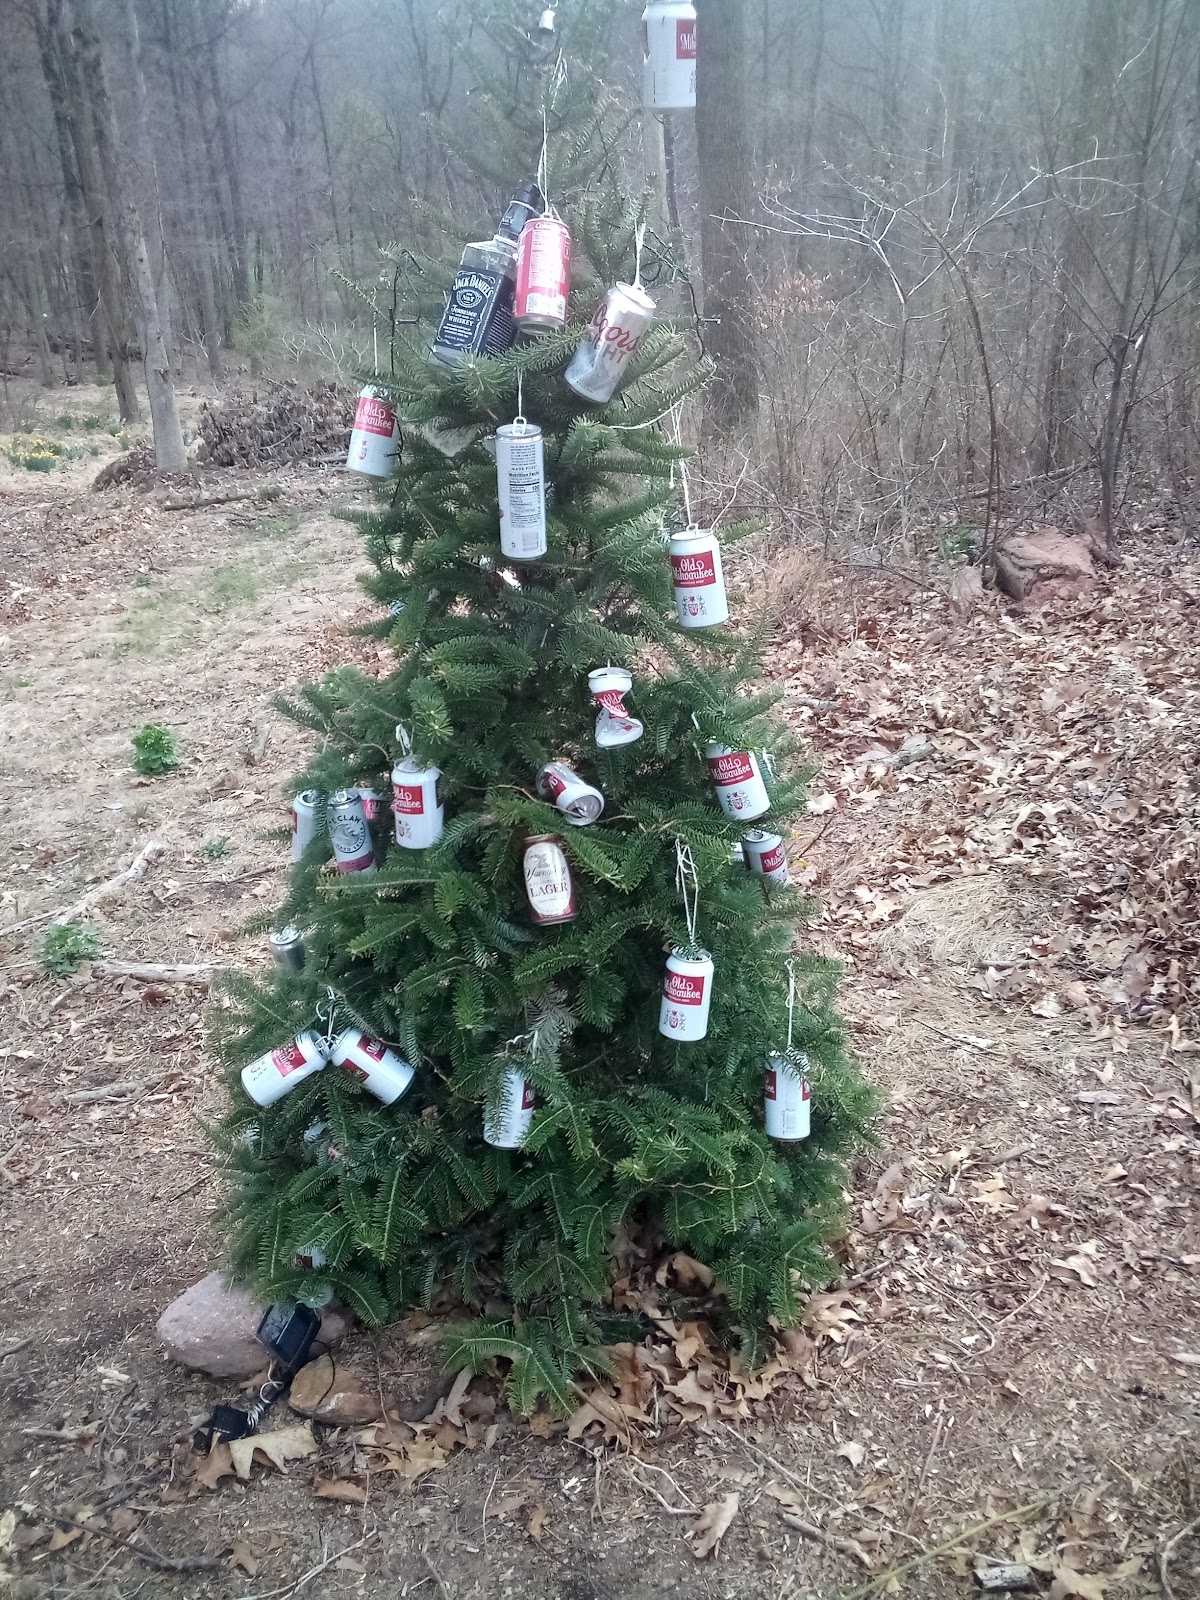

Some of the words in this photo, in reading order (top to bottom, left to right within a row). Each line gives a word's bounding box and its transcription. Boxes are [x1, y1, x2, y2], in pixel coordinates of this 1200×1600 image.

[453, 276, 471, 291] JACK
[470, 274, 494, 299] DANIEL'S
[448, 315, 475, 327] WHISKEY
[363, 401, 386, 419] Old
[680, 557, 705, 572] Old
[672, 566, 714, 581] Milwaukee
[711, 764, 751, 780] Milwaukee
[719, 757, 742, 772] Old
[337, 815, 362, 824] CLAW
[530, 881, 568, 898] LAGER
[664, 976, 702, 999] Milwaukee
[671, 975, 694, 990] Old
